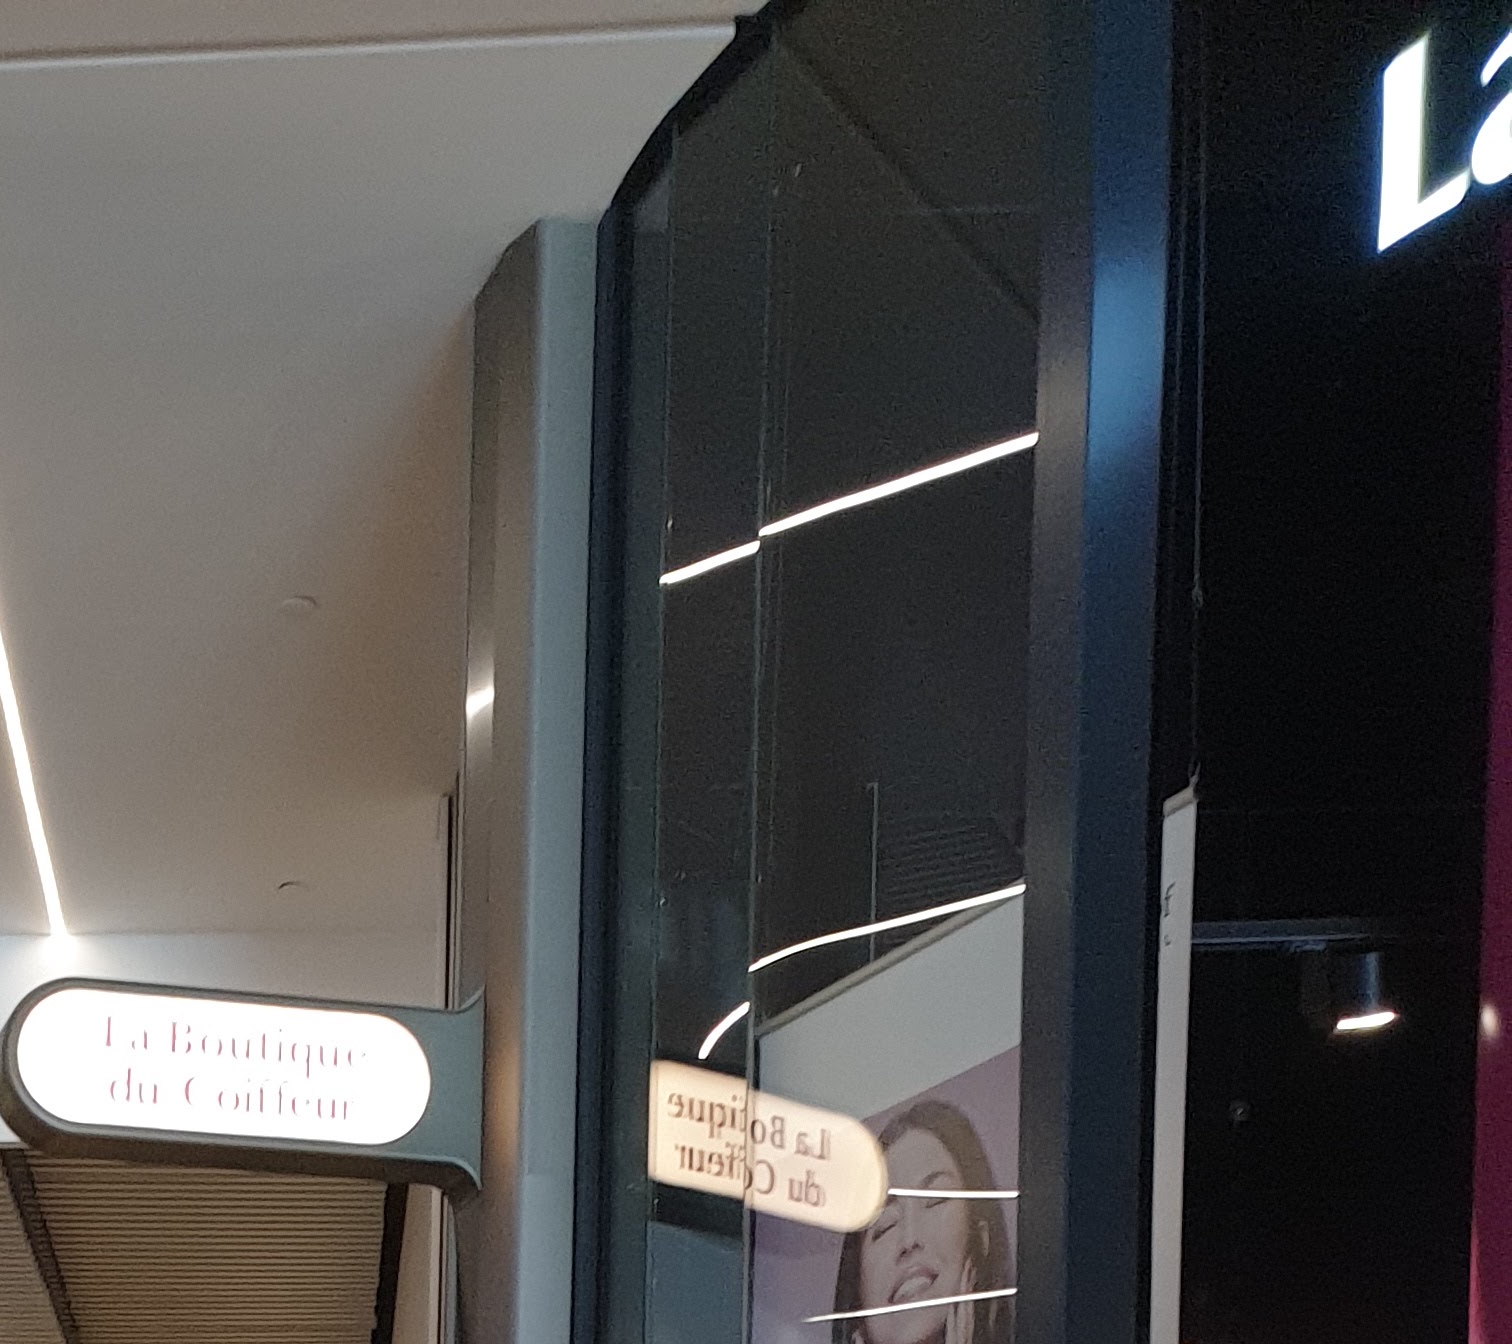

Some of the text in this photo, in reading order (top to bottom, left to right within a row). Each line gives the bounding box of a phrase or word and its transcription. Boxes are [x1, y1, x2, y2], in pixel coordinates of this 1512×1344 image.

[100, 1016, 366, 1078] La Boutique
[109, 1067, 355, 1120] du Coiffeur
